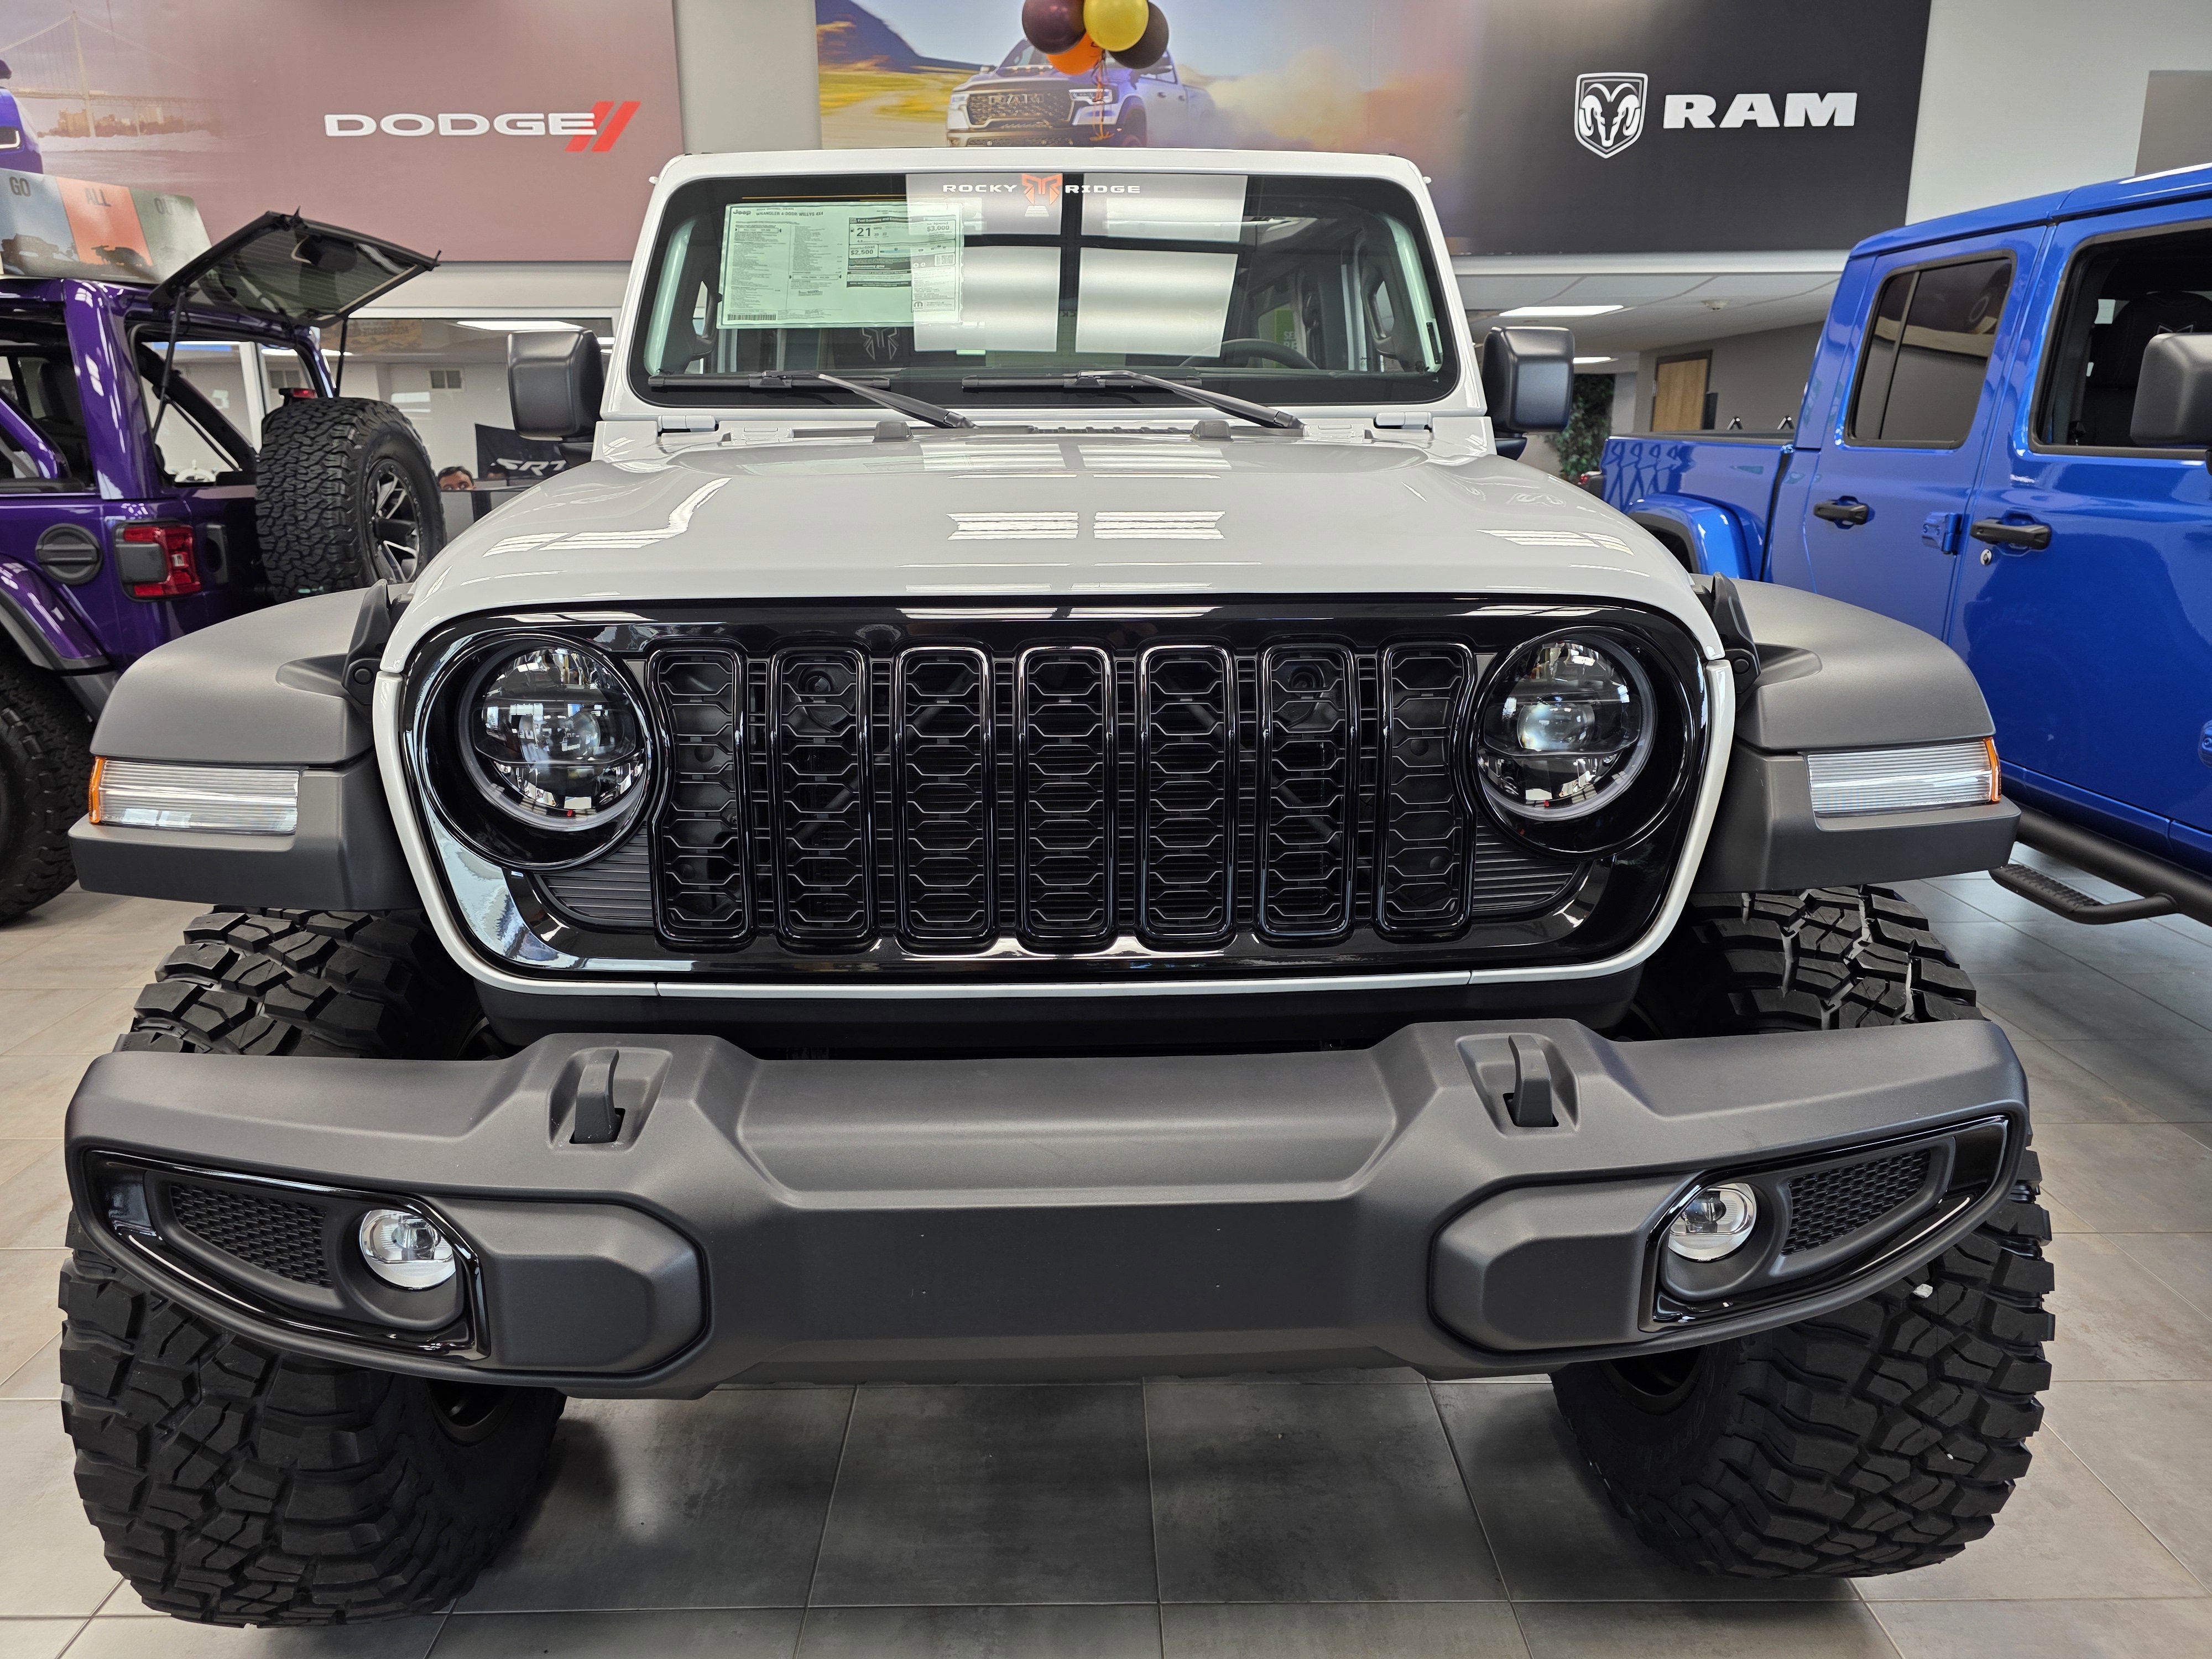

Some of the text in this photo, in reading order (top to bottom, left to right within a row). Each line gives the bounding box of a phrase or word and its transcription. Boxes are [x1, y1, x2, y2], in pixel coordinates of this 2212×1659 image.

[1663, 92, 1858, 128] RAM
[324, 112, 597, 137] DODGE
[9, 176, 31, 197] GO
[84, 187, 112, 207] ALL
[1065, 185, 1141, 194] RIDGE
[856, 227, 870, 237] 21
